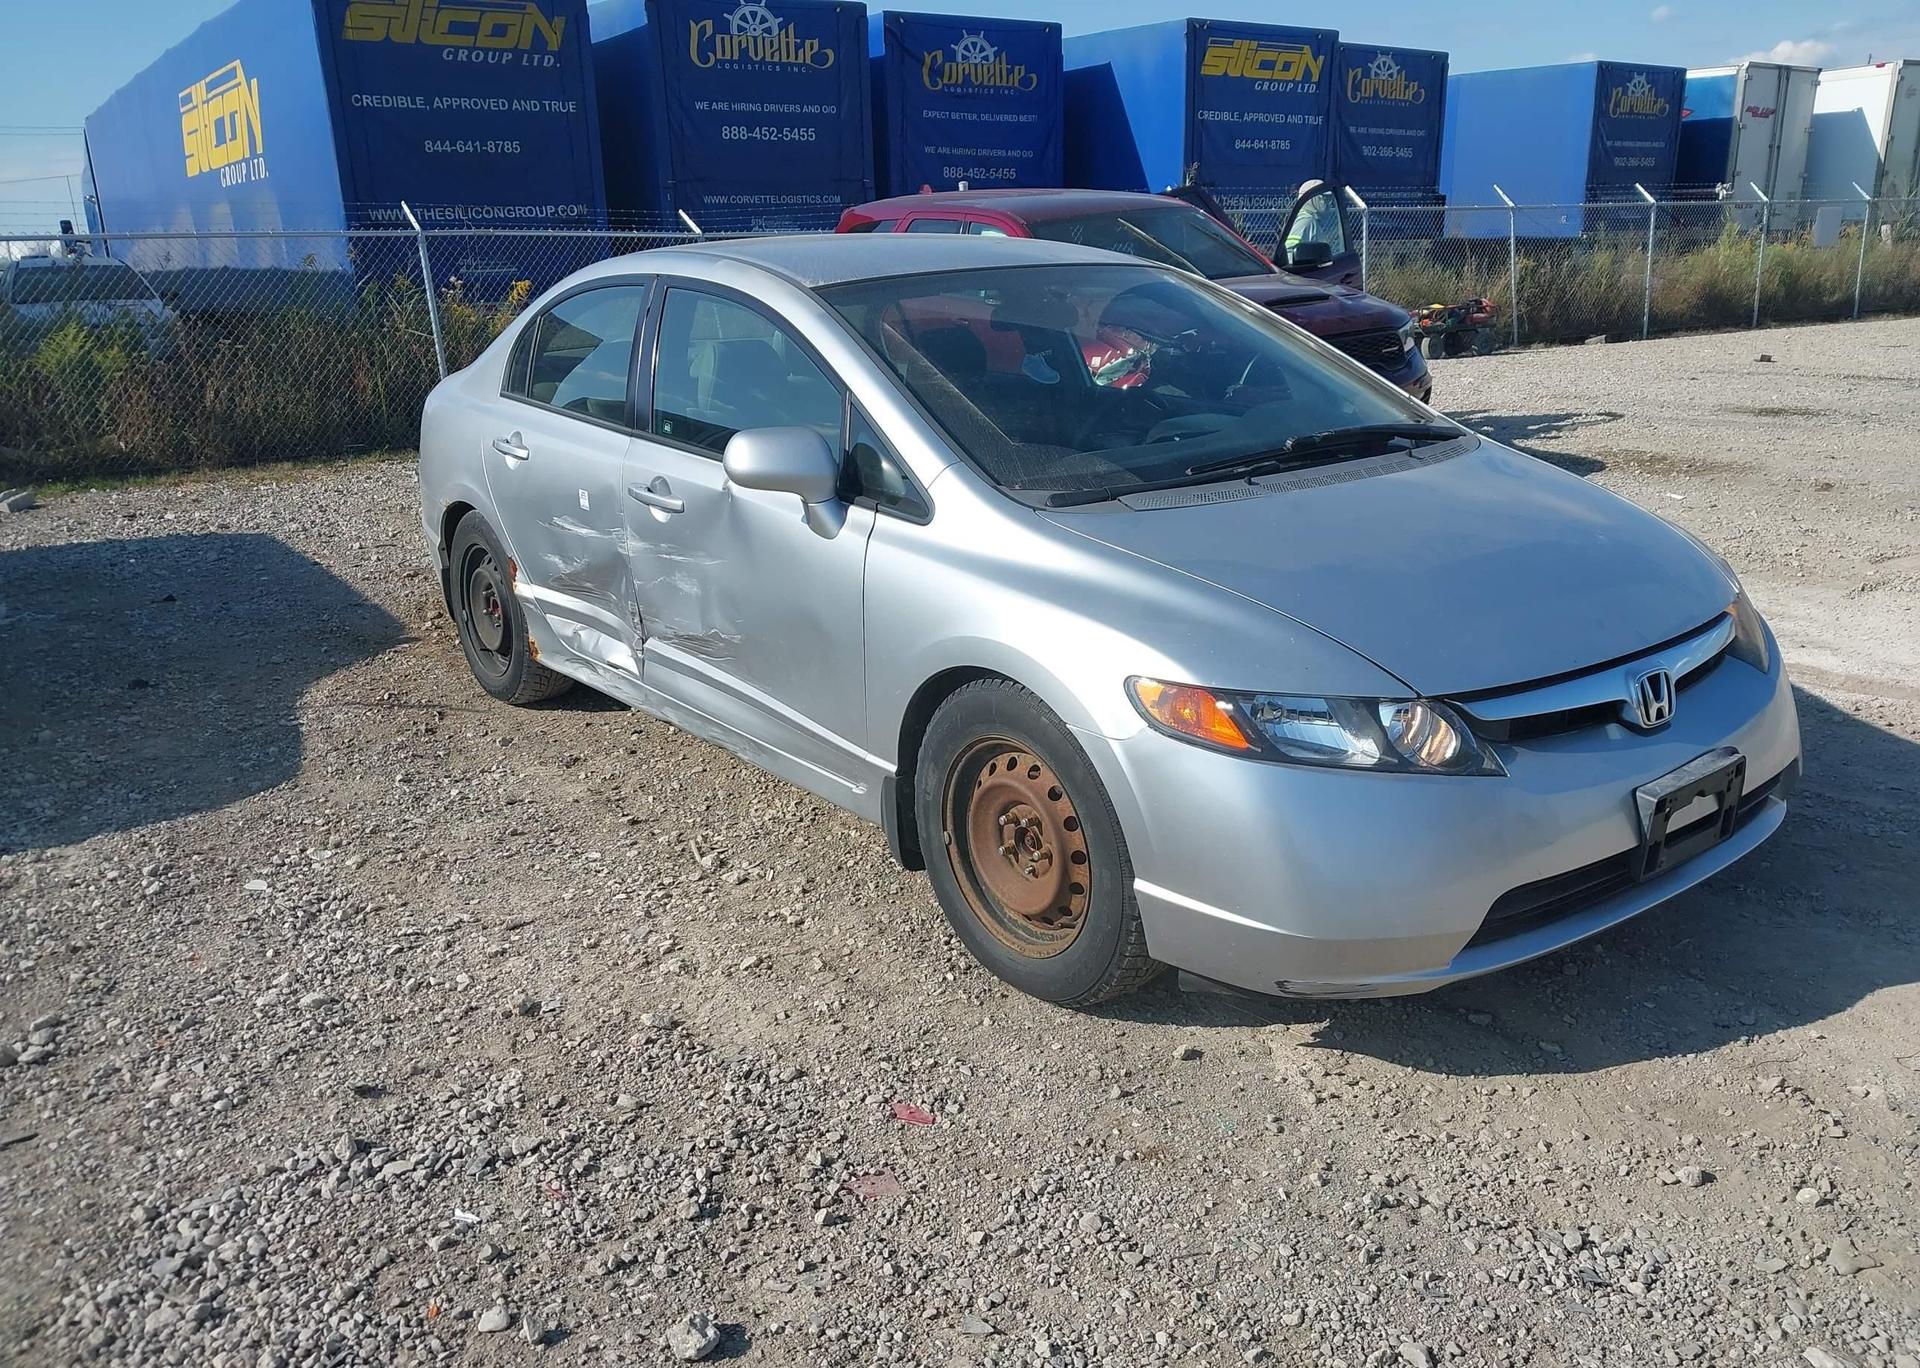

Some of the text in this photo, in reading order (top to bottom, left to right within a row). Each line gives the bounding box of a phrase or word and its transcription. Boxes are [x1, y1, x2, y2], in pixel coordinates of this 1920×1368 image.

[689, 19, 835, 69] Corvette
[442, 48, 561, 68] GROUP LTD.
[717, 62, 813, 73] LOGISTICS INC.
[922, 50, 1038, 91] Corvette
[1254, 81, 1320, 93] GROUP LTD.
[351, 94, 577, 113] CREDIBLE, APPROVED AND TRUE
[695, 101, 710, 110] WE
[711, 102, 730, 111] ARE
[731, 102, 762, 112] HIRING
[763, 103, 801, 113] DRIVERS
[802, 104, 820, 113] AND
[923, 110, 949, 119] EXPECT
[981, 113, 1018, 122] DELIVERED
[1198, 110, 1241, 122] CREDIBLE,
[1243, 112, 1285, 123] APPROVED
[1287, 114, 1303, 124] AND
[721, 126, 816, 141] 888-452-5455
[424, 140, 521, 153] 844-641-8785
[1235, 139, 1291, 150] 844-641-8785
[937, 146, 951, 154] ARE
[952, 147, 976, 156] HIRING
[978, 149, 1006, 157] DRIVERS
[220, 157, 269, 187] GROUP LTD.
[943, 166, 1017, 179] 888-452-5455
